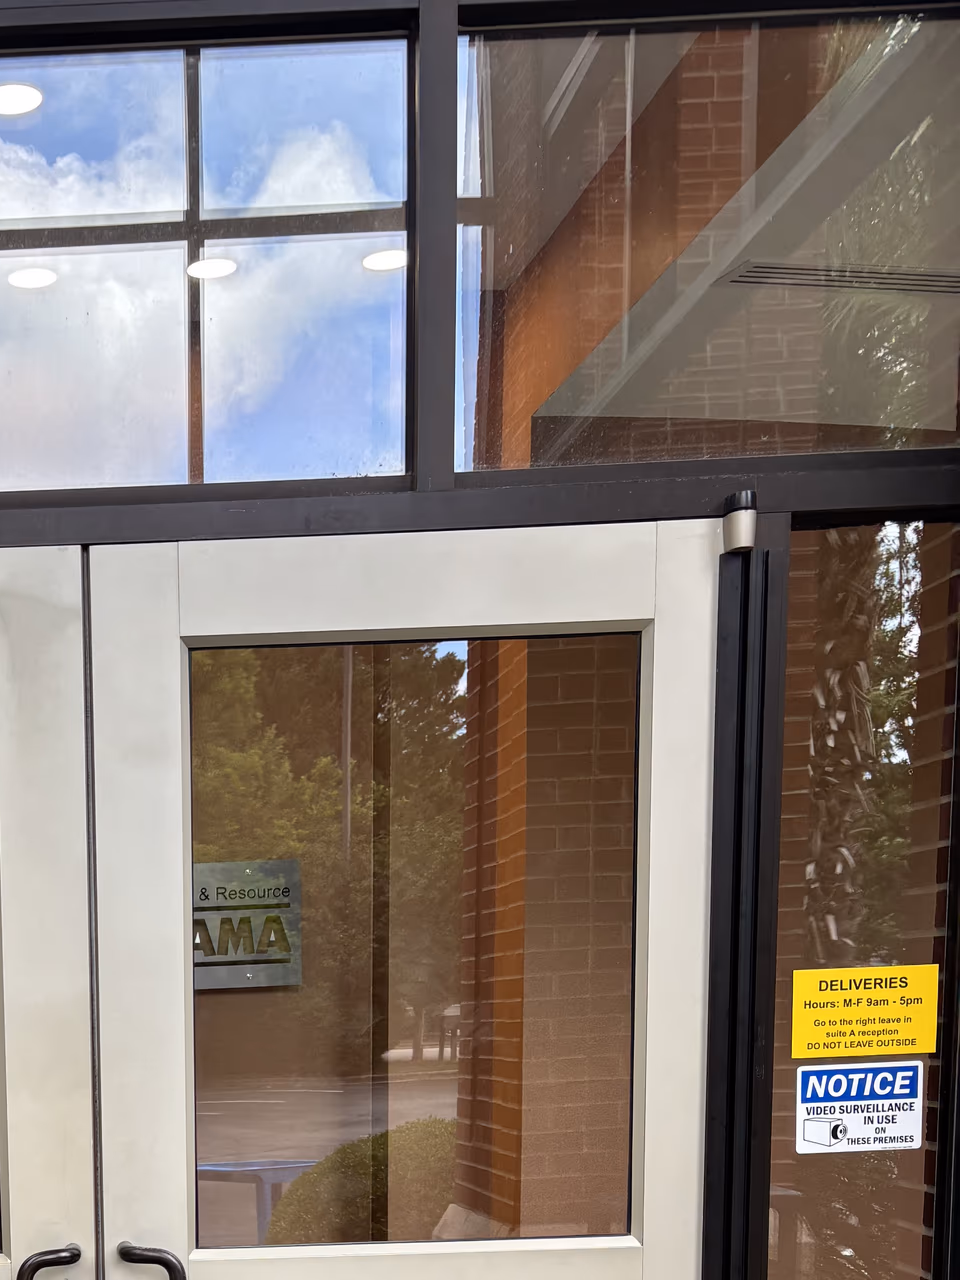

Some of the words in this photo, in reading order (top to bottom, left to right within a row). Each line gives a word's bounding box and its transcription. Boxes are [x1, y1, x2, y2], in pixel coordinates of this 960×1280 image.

[199, 887, 210, 901] &
[215, 886, 291, 901] Resource
[818, 976, 909, 992] DELIVERIES
[803, 1000, 840, 1009] Hours:
[843, 998, 863, 1007] M-F
[866, 997, 889, 1007] 9am
[899, 996, 923, 1007] 5pm
[813, 1019, 826, 1027] Go
[839, 1018, 853, 1026] the
[855, 1017, 876, 1027] right
[878, 1016, 901, 1024] leave
[825, 1030, 847, 1038] suite
[849, 1029, 856, 1037] A
[858, 1028, 899, 1038] reception
[807, 1042, 820, 1050] DO
[823, 1041, 842, 1049] NOT
[844, 1040, 874, 1049] LEAVE
[876, 1038, 917, 1048] OUTSIDE
[806, 1071, 914, 1099] NOTICE
[806, 1105, 836, 1116] VIDEO
[838, 1102, 916, 1114] SURVEILLANCE
[863, 1116, 874, 1125] IN
[877, 1115, 898, 1124] USE
[874, 1127, 887, 1135] ON
[846, 1137, 872, 1146] THESE
[873, 1135, 915, 1145] PREMISES
